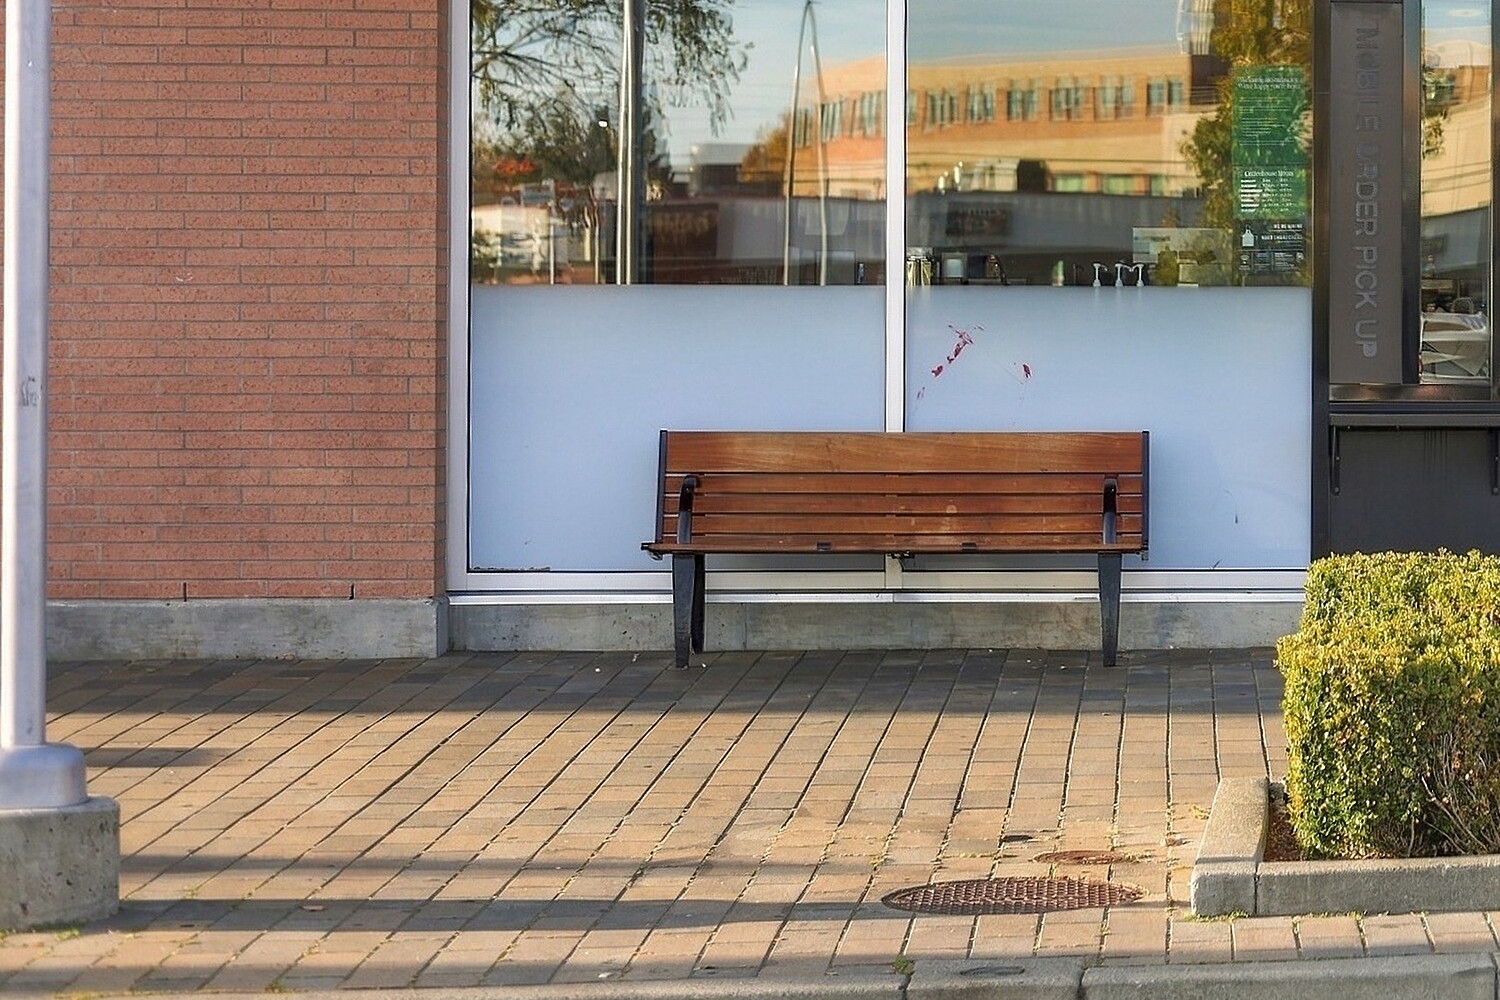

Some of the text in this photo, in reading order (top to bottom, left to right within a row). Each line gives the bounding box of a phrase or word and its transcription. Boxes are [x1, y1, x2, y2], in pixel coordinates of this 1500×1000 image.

[1355, 24, 1379, 359] MOBILE ORDER PICK UP
